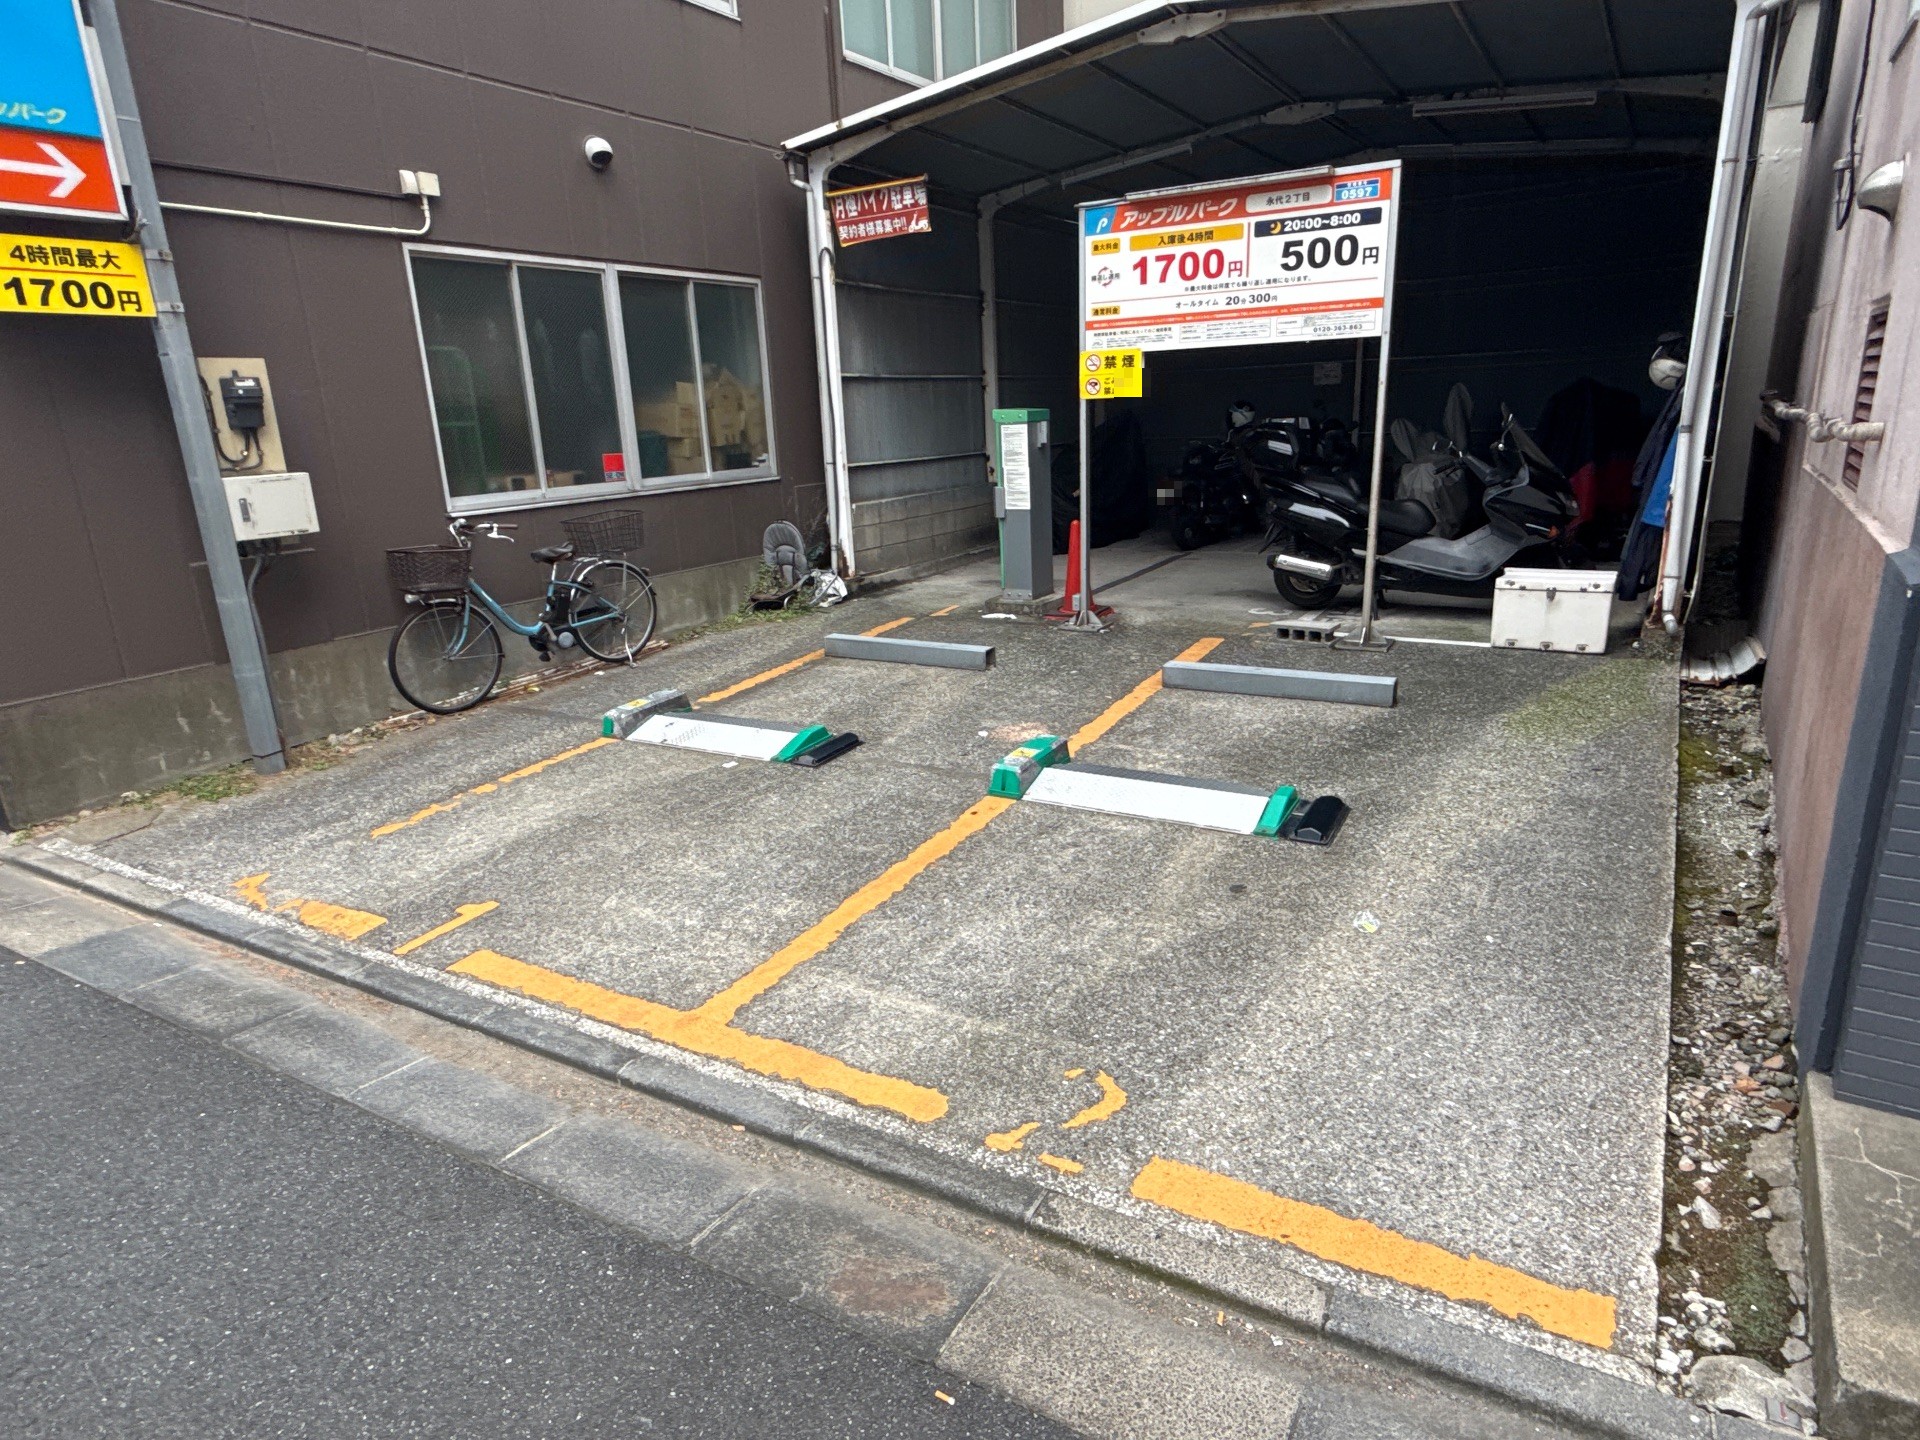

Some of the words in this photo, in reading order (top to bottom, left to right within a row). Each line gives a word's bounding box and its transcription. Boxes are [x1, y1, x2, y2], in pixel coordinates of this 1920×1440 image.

[0, 102, 67, 125] パーク
[835, 185, 927, 219] 月極バイク駐車場
[1265, 192, 1311, 206] 永代2丁目
[1341, 187, 1373, 200] 0597
[1119, 198, 1238, 229] アップルパーク
[1093, 242, 1120, 252] 最大料金
[1157, 230, 1214, 246] 入庫後4時間
[9, 244, 121, 270] 4時間最大
[1280, 234, 1379, 272] 500円
[1132, 248, 1243, 286] 1700円
[3, 276, 142, 312] 1700円
[1104, 354, 1135, 369] 禁煙
